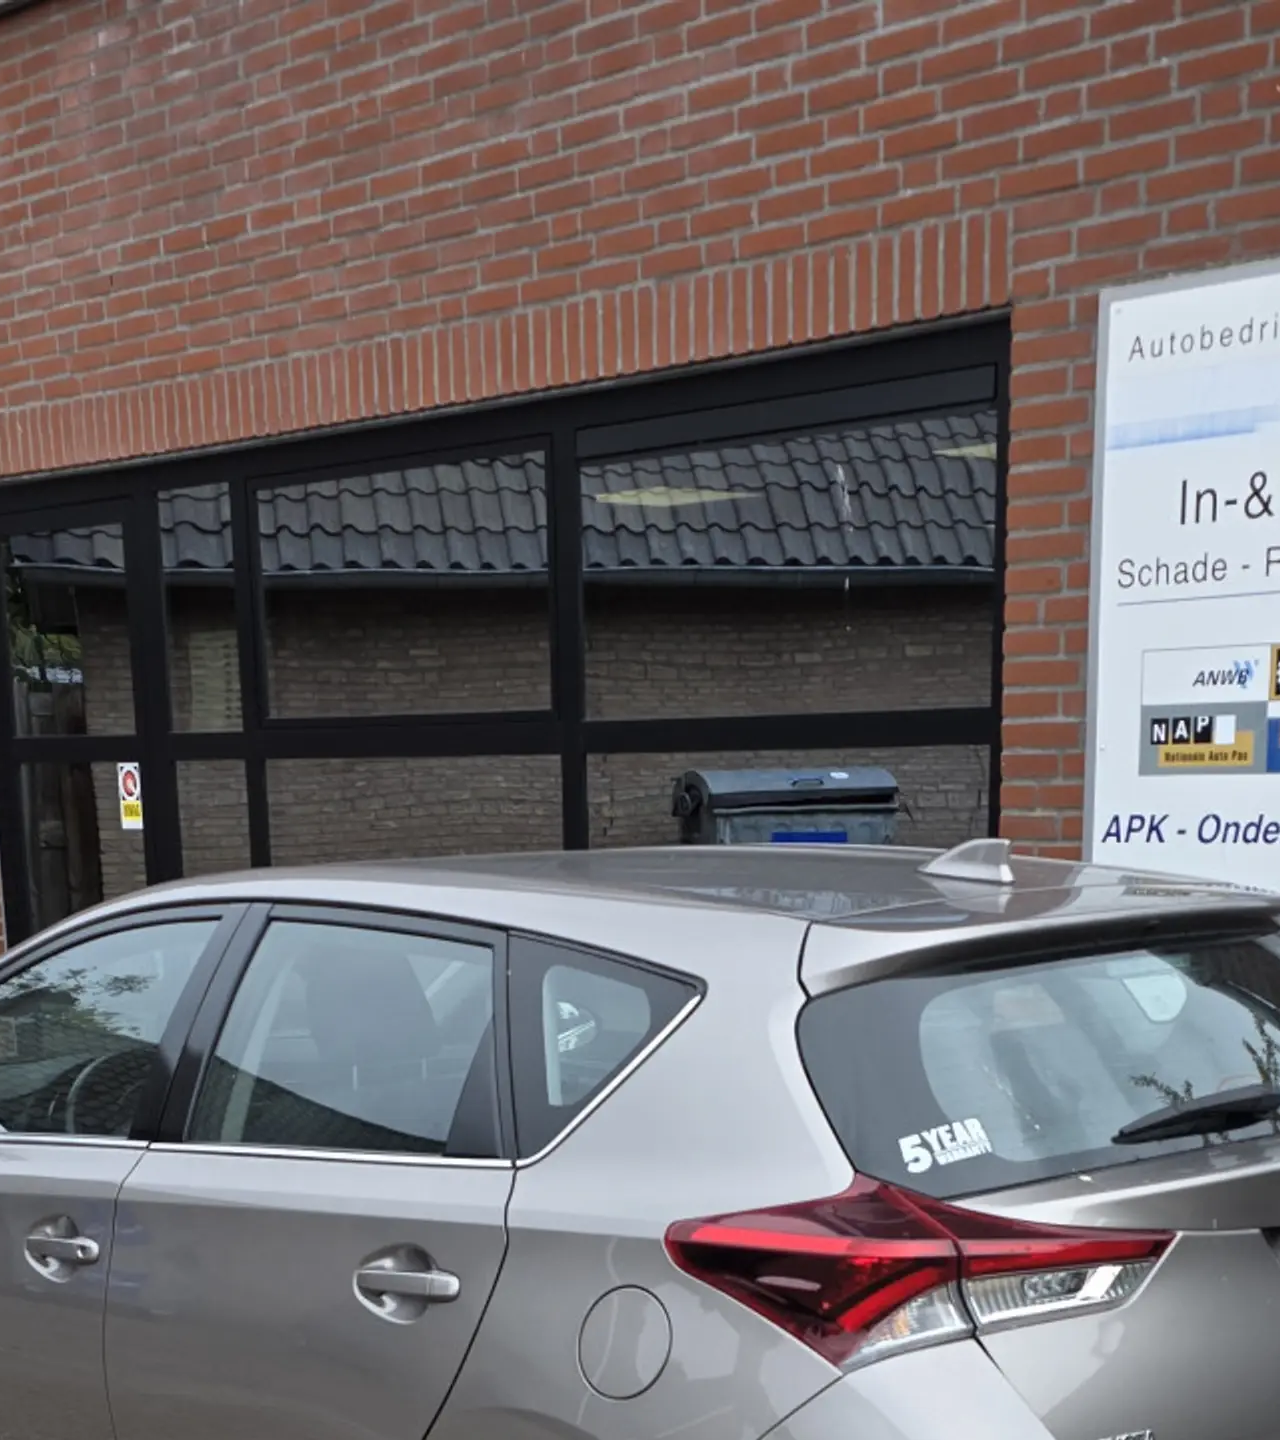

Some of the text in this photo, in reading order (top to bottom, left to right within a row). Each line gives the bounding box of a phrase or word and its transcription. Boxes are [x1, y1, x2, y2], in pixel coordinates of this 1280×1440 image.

[1117, 551, 1228, 589] Schade
[1192, 669, 1250, 687] ANWB
[1153, 715, 1209, 743] NAP
[1101, 814, 1170, 844] APK
[898, 1117, 989, 1174] 5 YEAR
